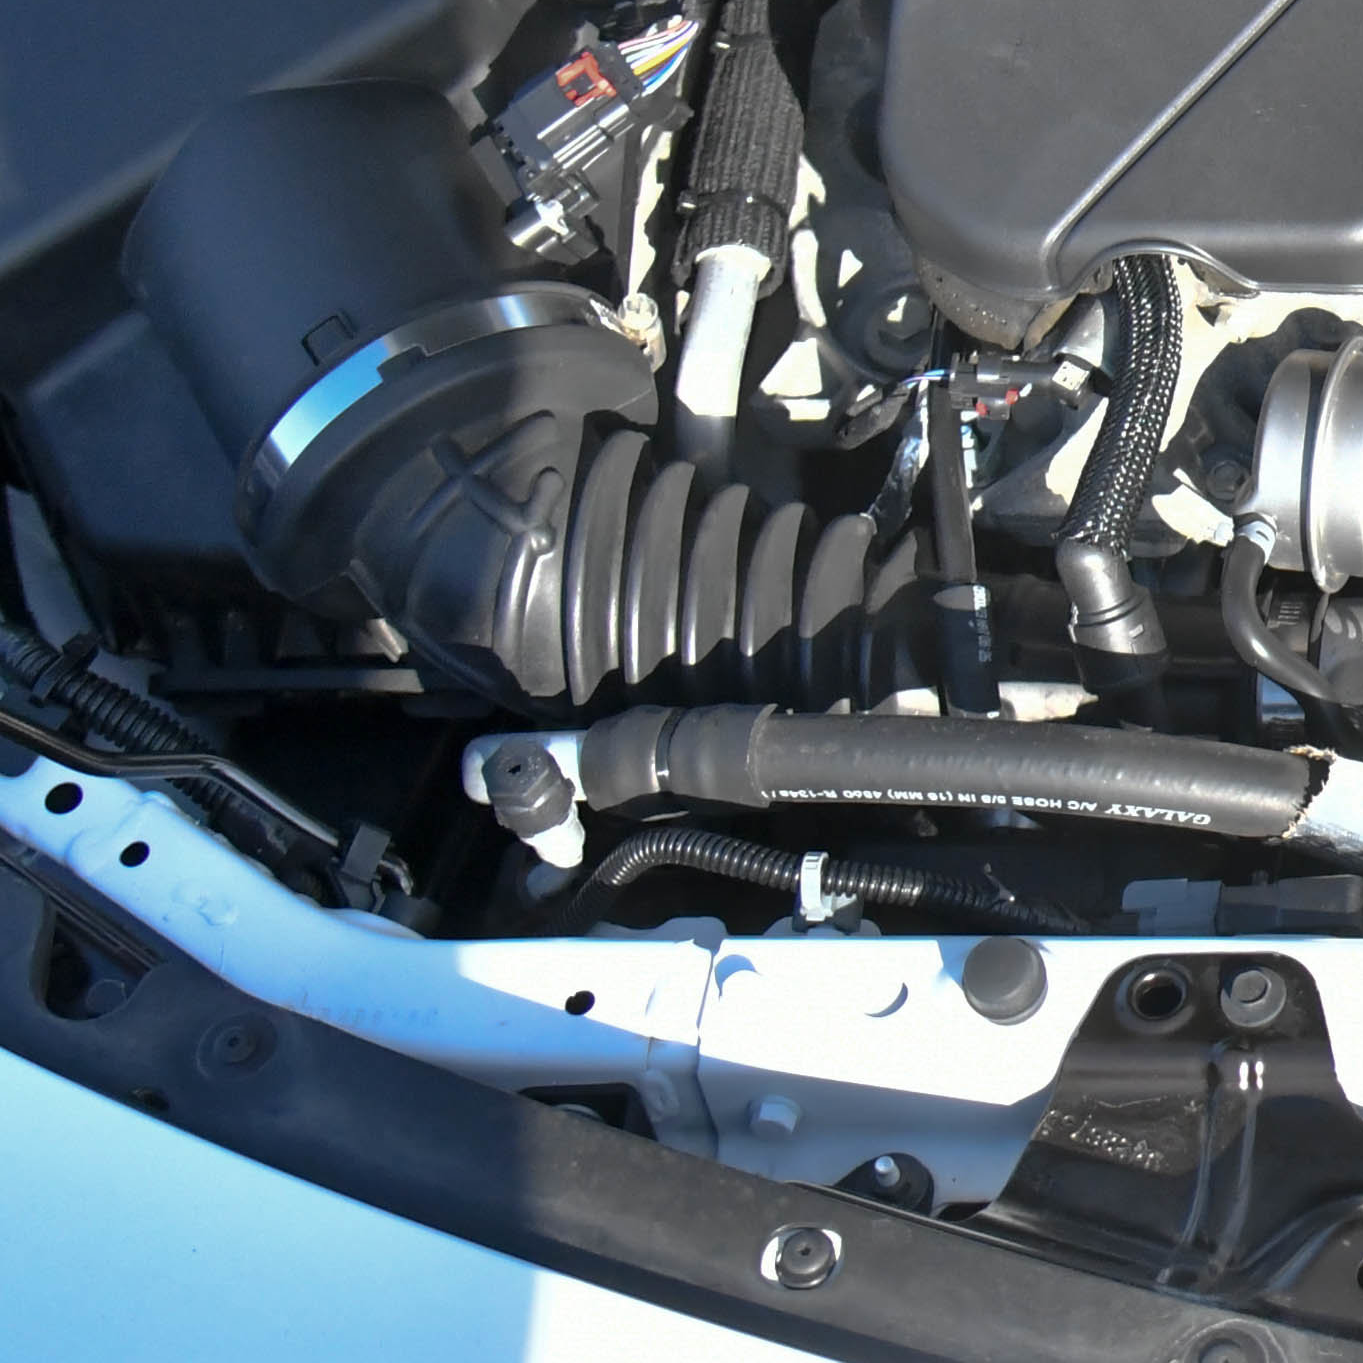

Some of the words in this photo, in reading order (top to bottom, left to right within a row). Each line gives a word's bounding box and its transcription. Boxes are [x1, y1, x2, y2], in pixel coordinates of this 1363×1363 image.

[1012, 795, 1062, 809] HOSE
[1067, 801, 1097, 812] A/C
[1105, 803, 1212, 825] GALAXY
